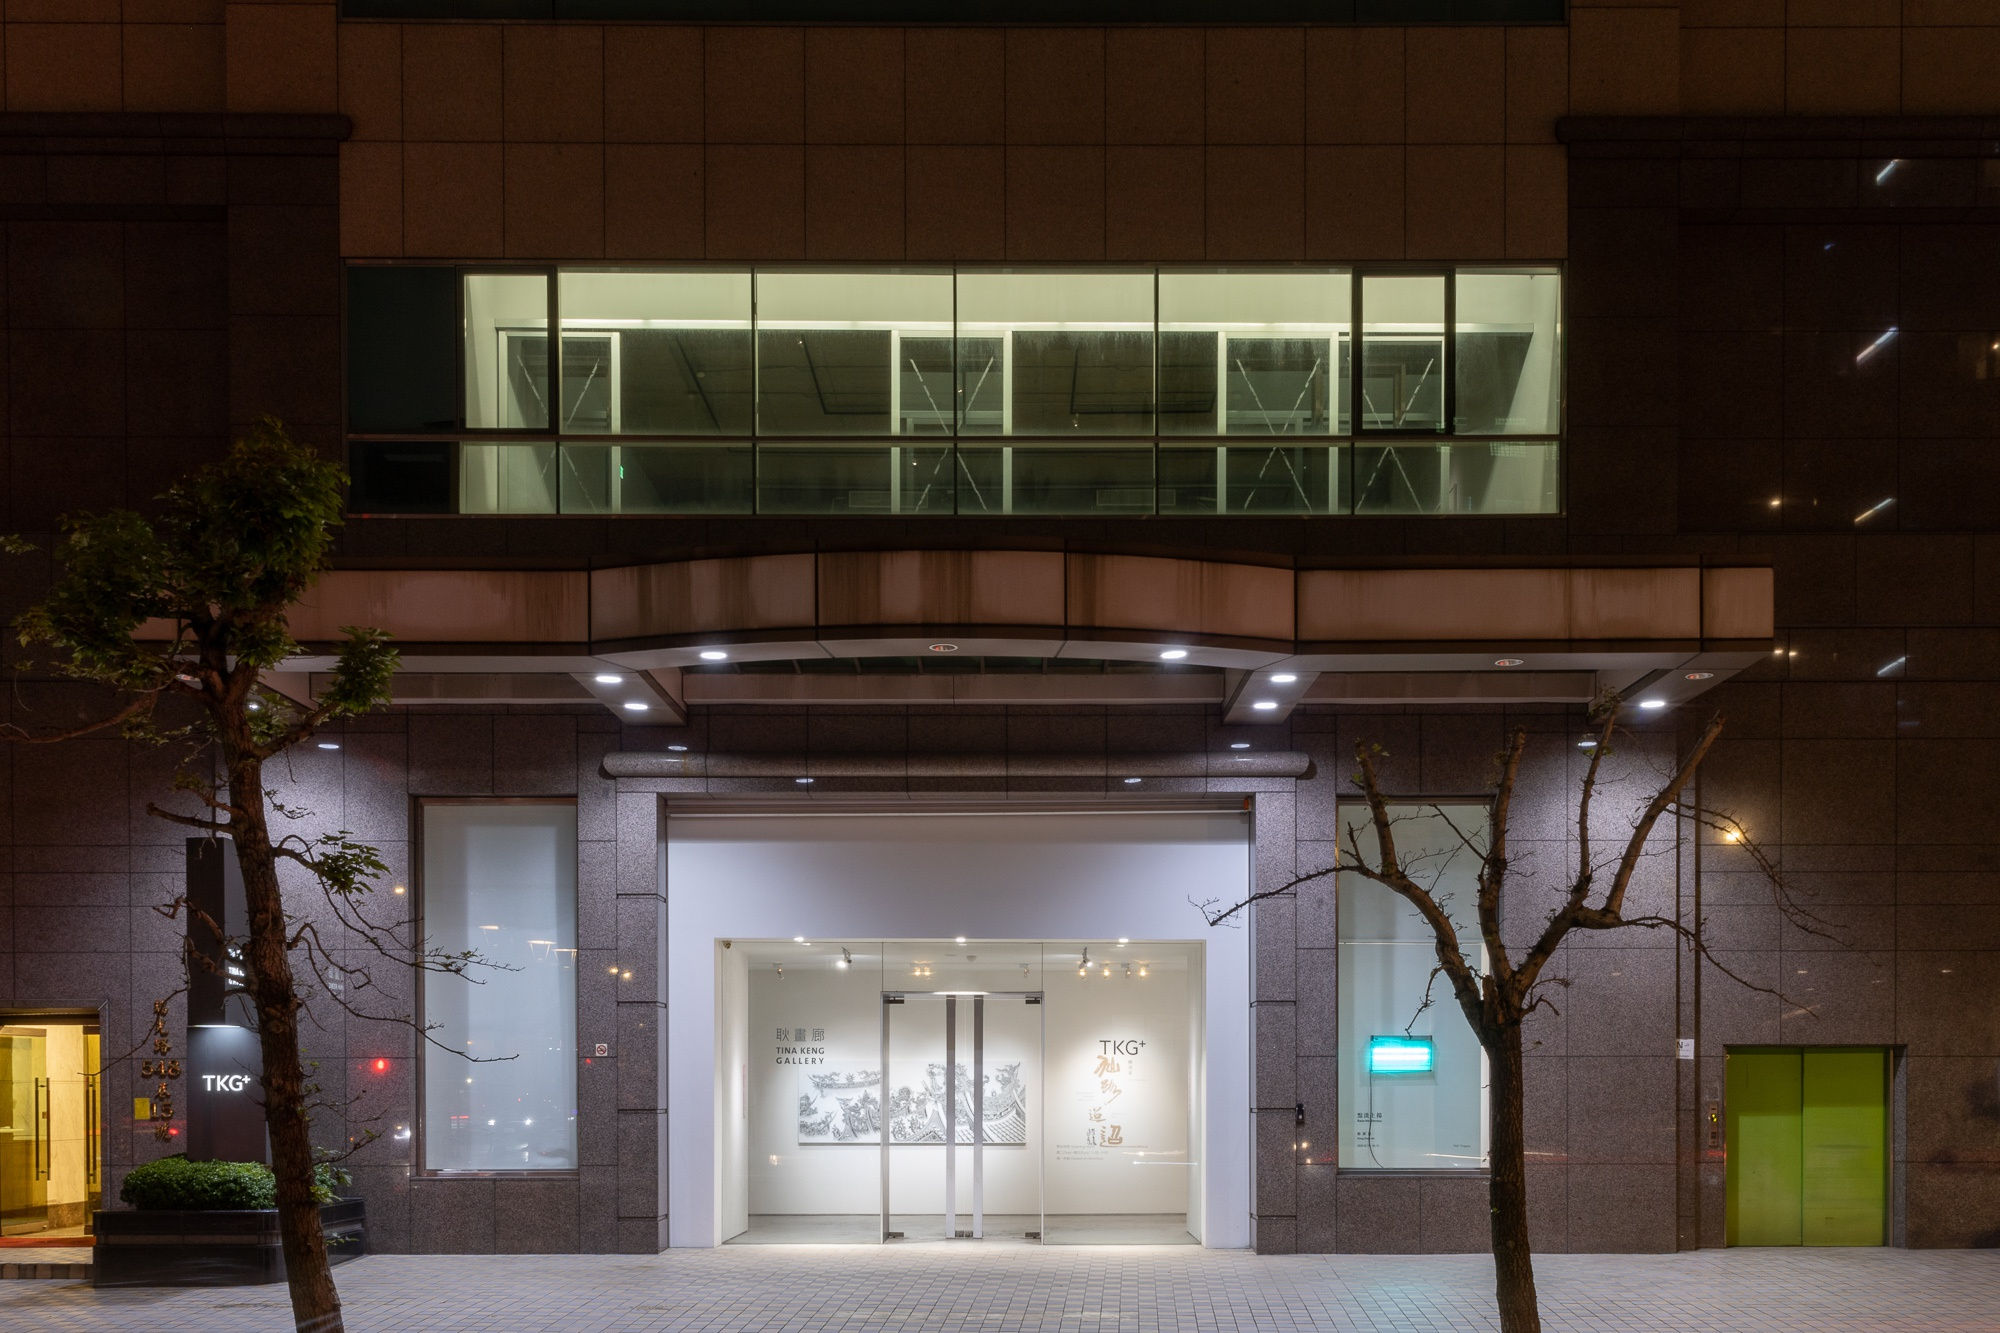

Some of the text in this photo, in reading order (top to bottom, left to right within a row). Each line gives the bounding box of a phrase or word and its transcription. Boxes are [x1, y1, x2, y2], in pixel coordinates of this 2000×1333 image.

[776, 1047, 825, 1055] TINA KENG
[1099, 1040, 1146, 1055] TKG+
[776, 1057, 825, 1065] GALLERY
[202, 1074, 251, 1091] TKG+
